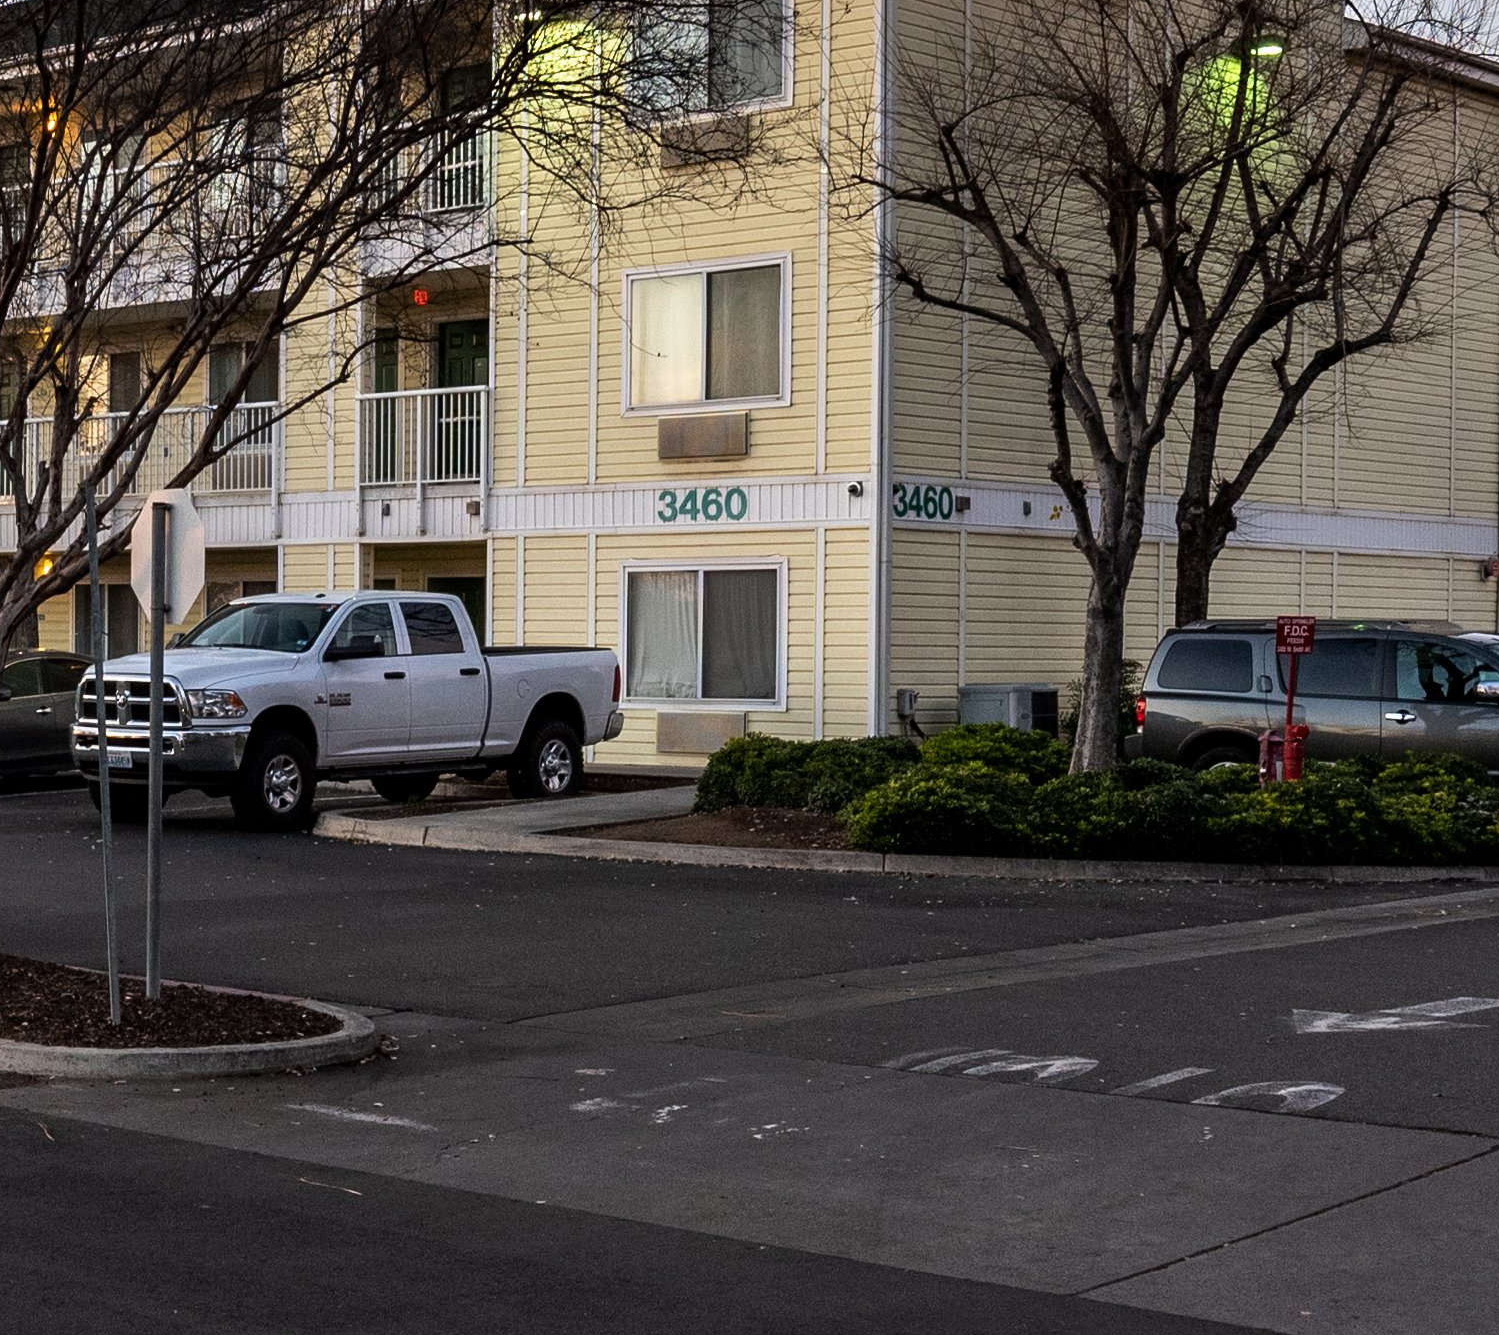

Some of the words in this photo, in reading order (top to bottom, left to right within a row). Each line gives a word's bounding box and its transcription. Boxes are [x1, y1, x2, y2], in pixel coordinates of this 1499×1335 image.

[657, 487, 748, 522] 3460
[893, 482, 954, 520] 3460
[1284, 625, 1309, 636] F.D.C.
